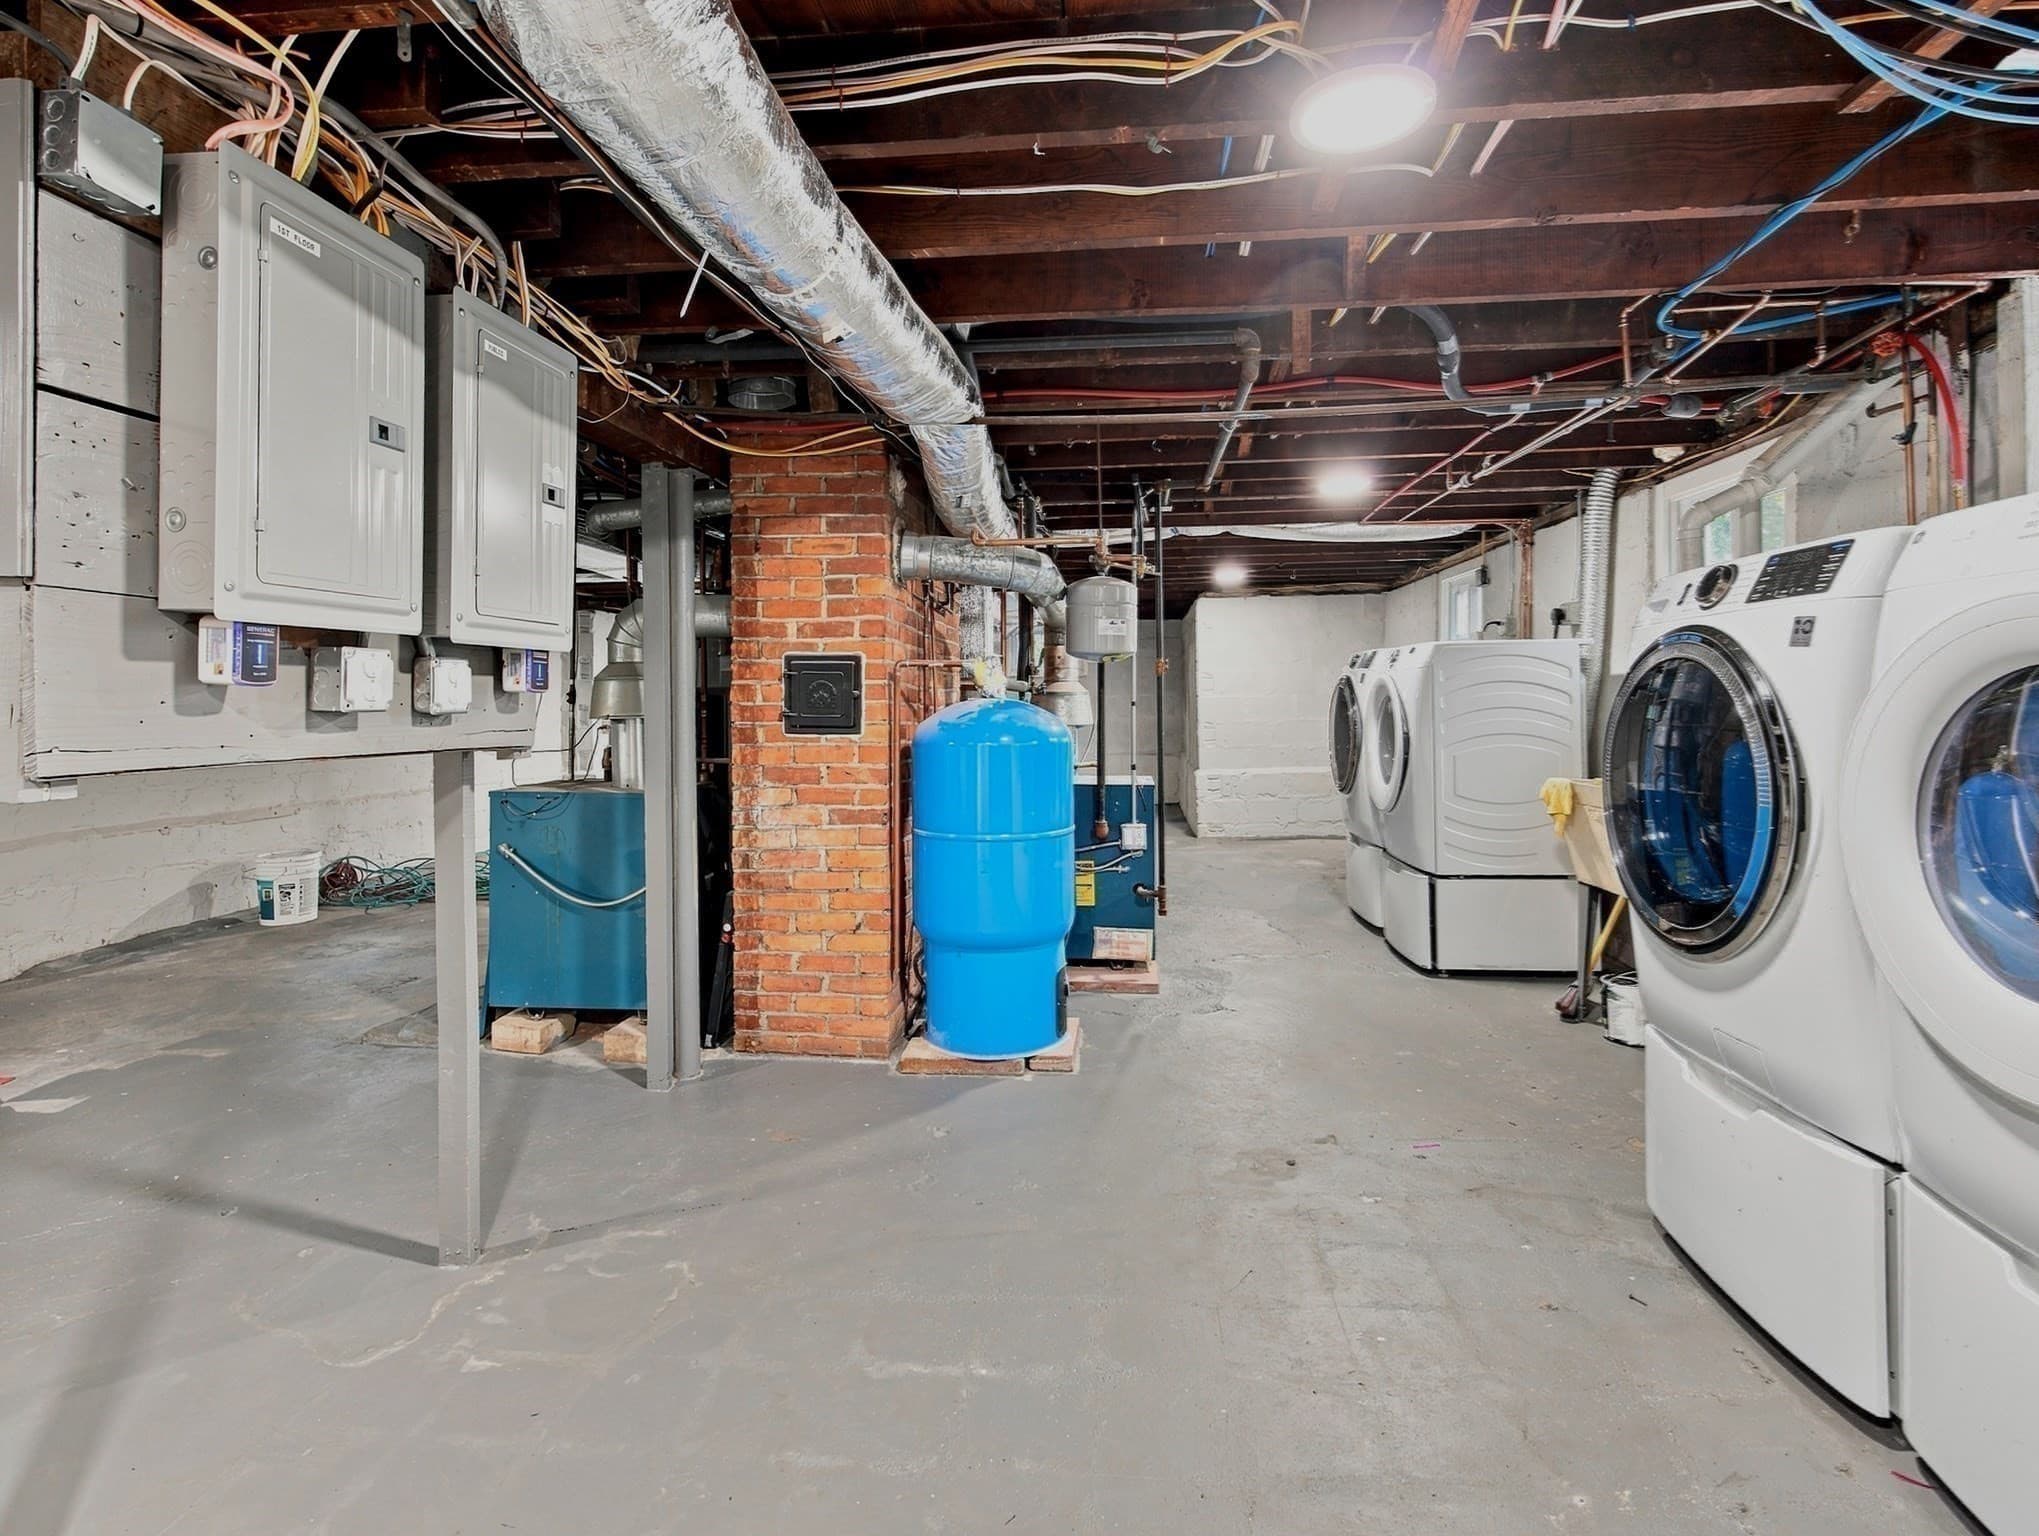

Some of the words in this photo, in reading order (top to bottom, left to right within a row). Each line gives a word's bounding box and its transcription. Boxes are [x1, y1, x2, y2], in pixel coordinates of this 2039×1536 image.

[278, 225, 290, 237] 1ST
[294, 234, 316, 251] FLOOR
[246, 625, 276, 634] GENERAC
